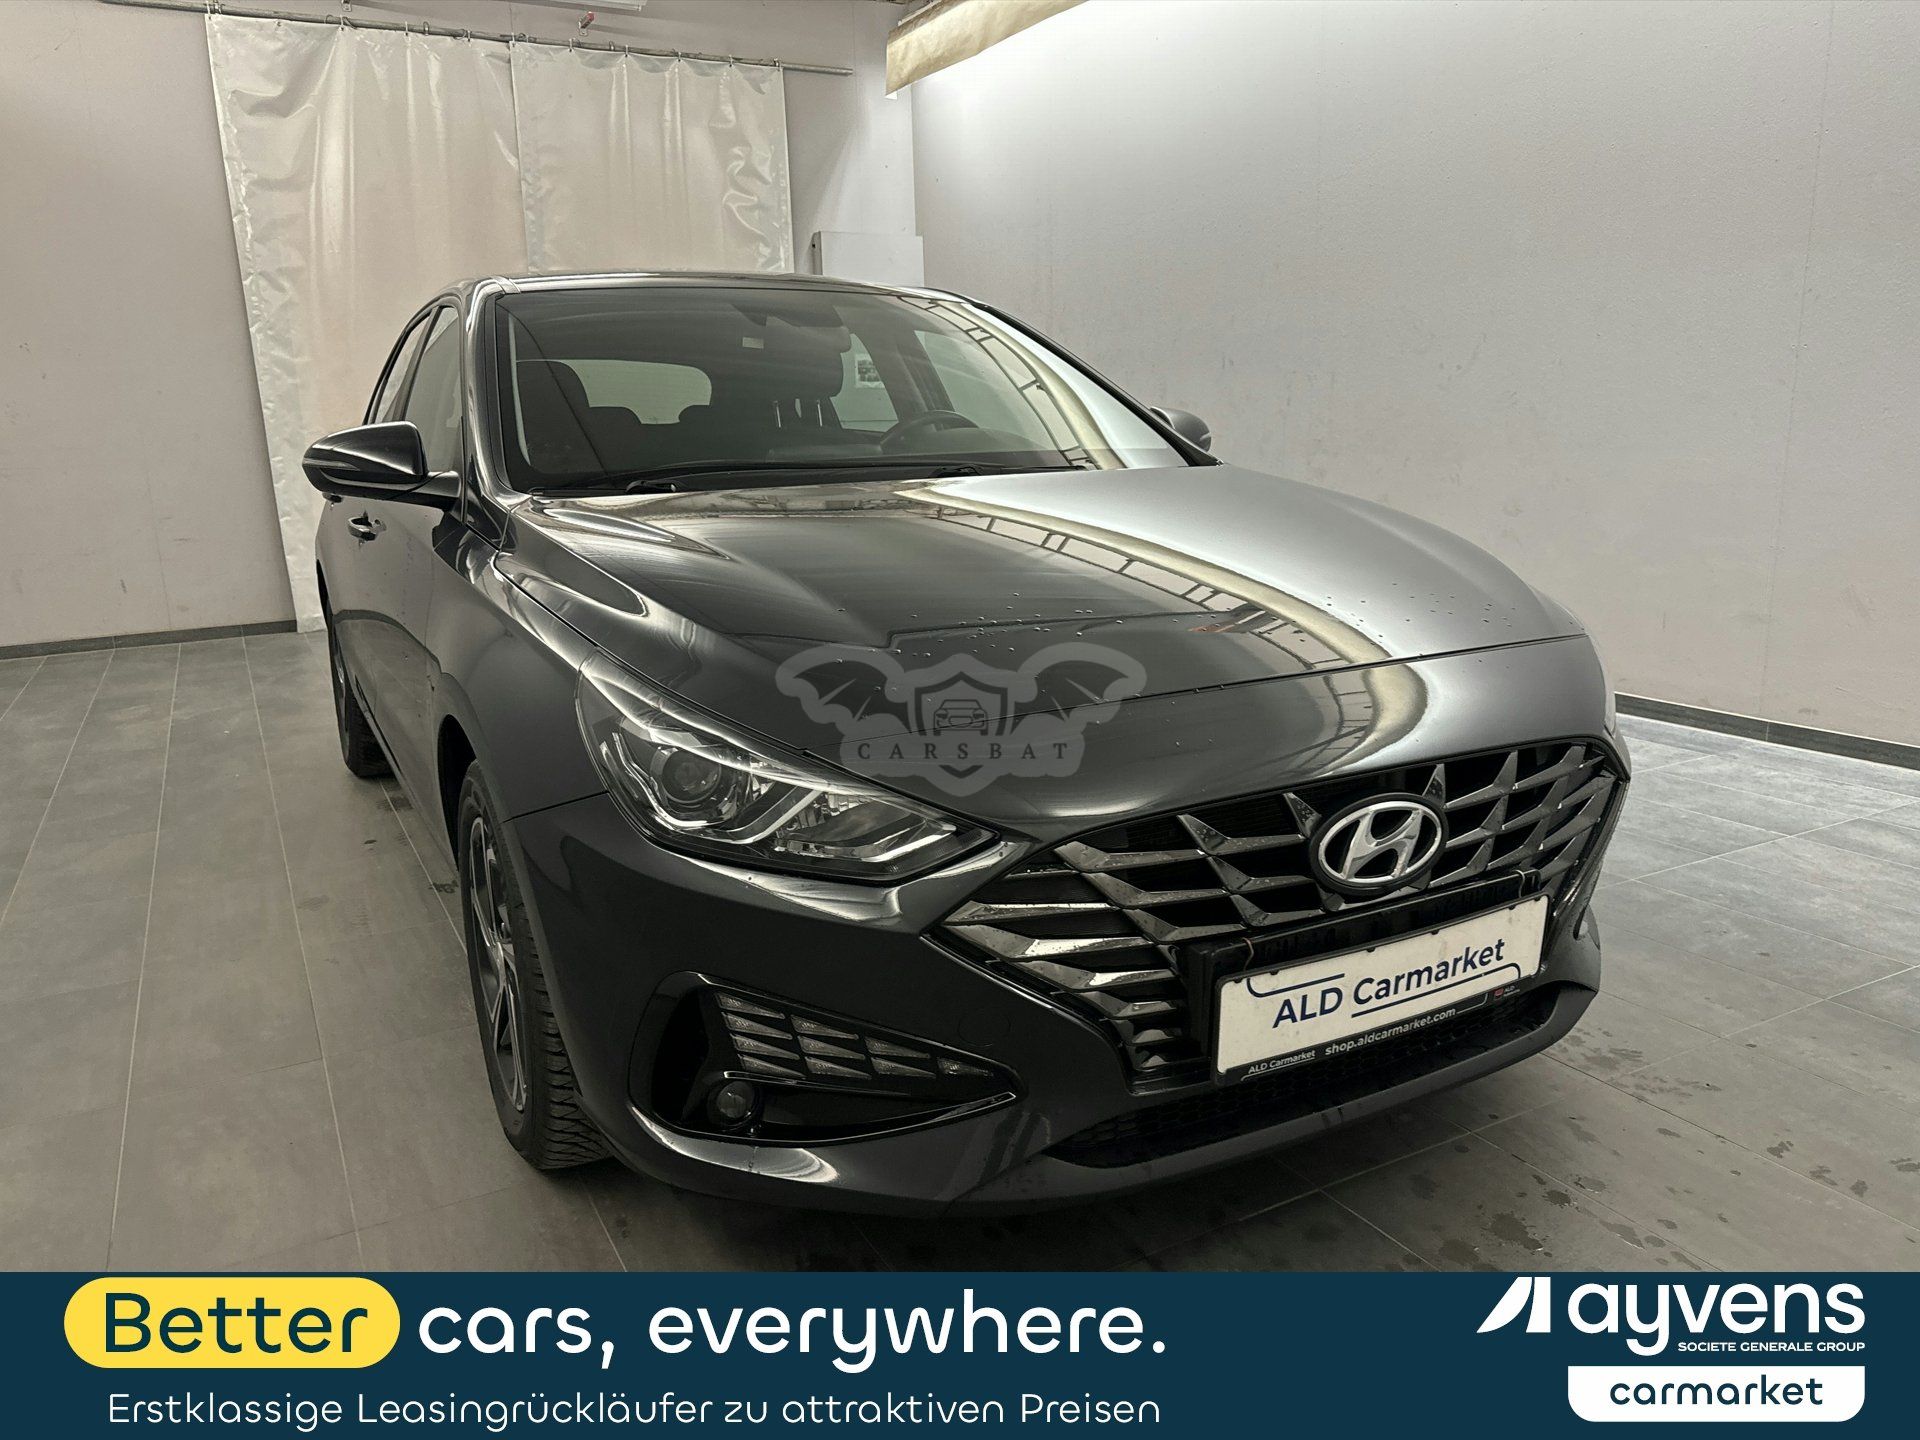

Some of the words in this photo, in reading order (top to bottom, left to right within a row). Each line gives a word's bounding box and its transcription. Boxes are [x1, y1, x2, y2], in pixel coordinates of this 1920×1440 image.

[1272, 987, 1343, 1029] ALD
[1353, 938, 1505, 1006] Carmarket
[1324, 1007, 1456, 1056] shop.aldcarmarket.com
[1248, 1060, 1270, 1074] ALD
[1268, 1050, 1316, 1069] Carmarket
